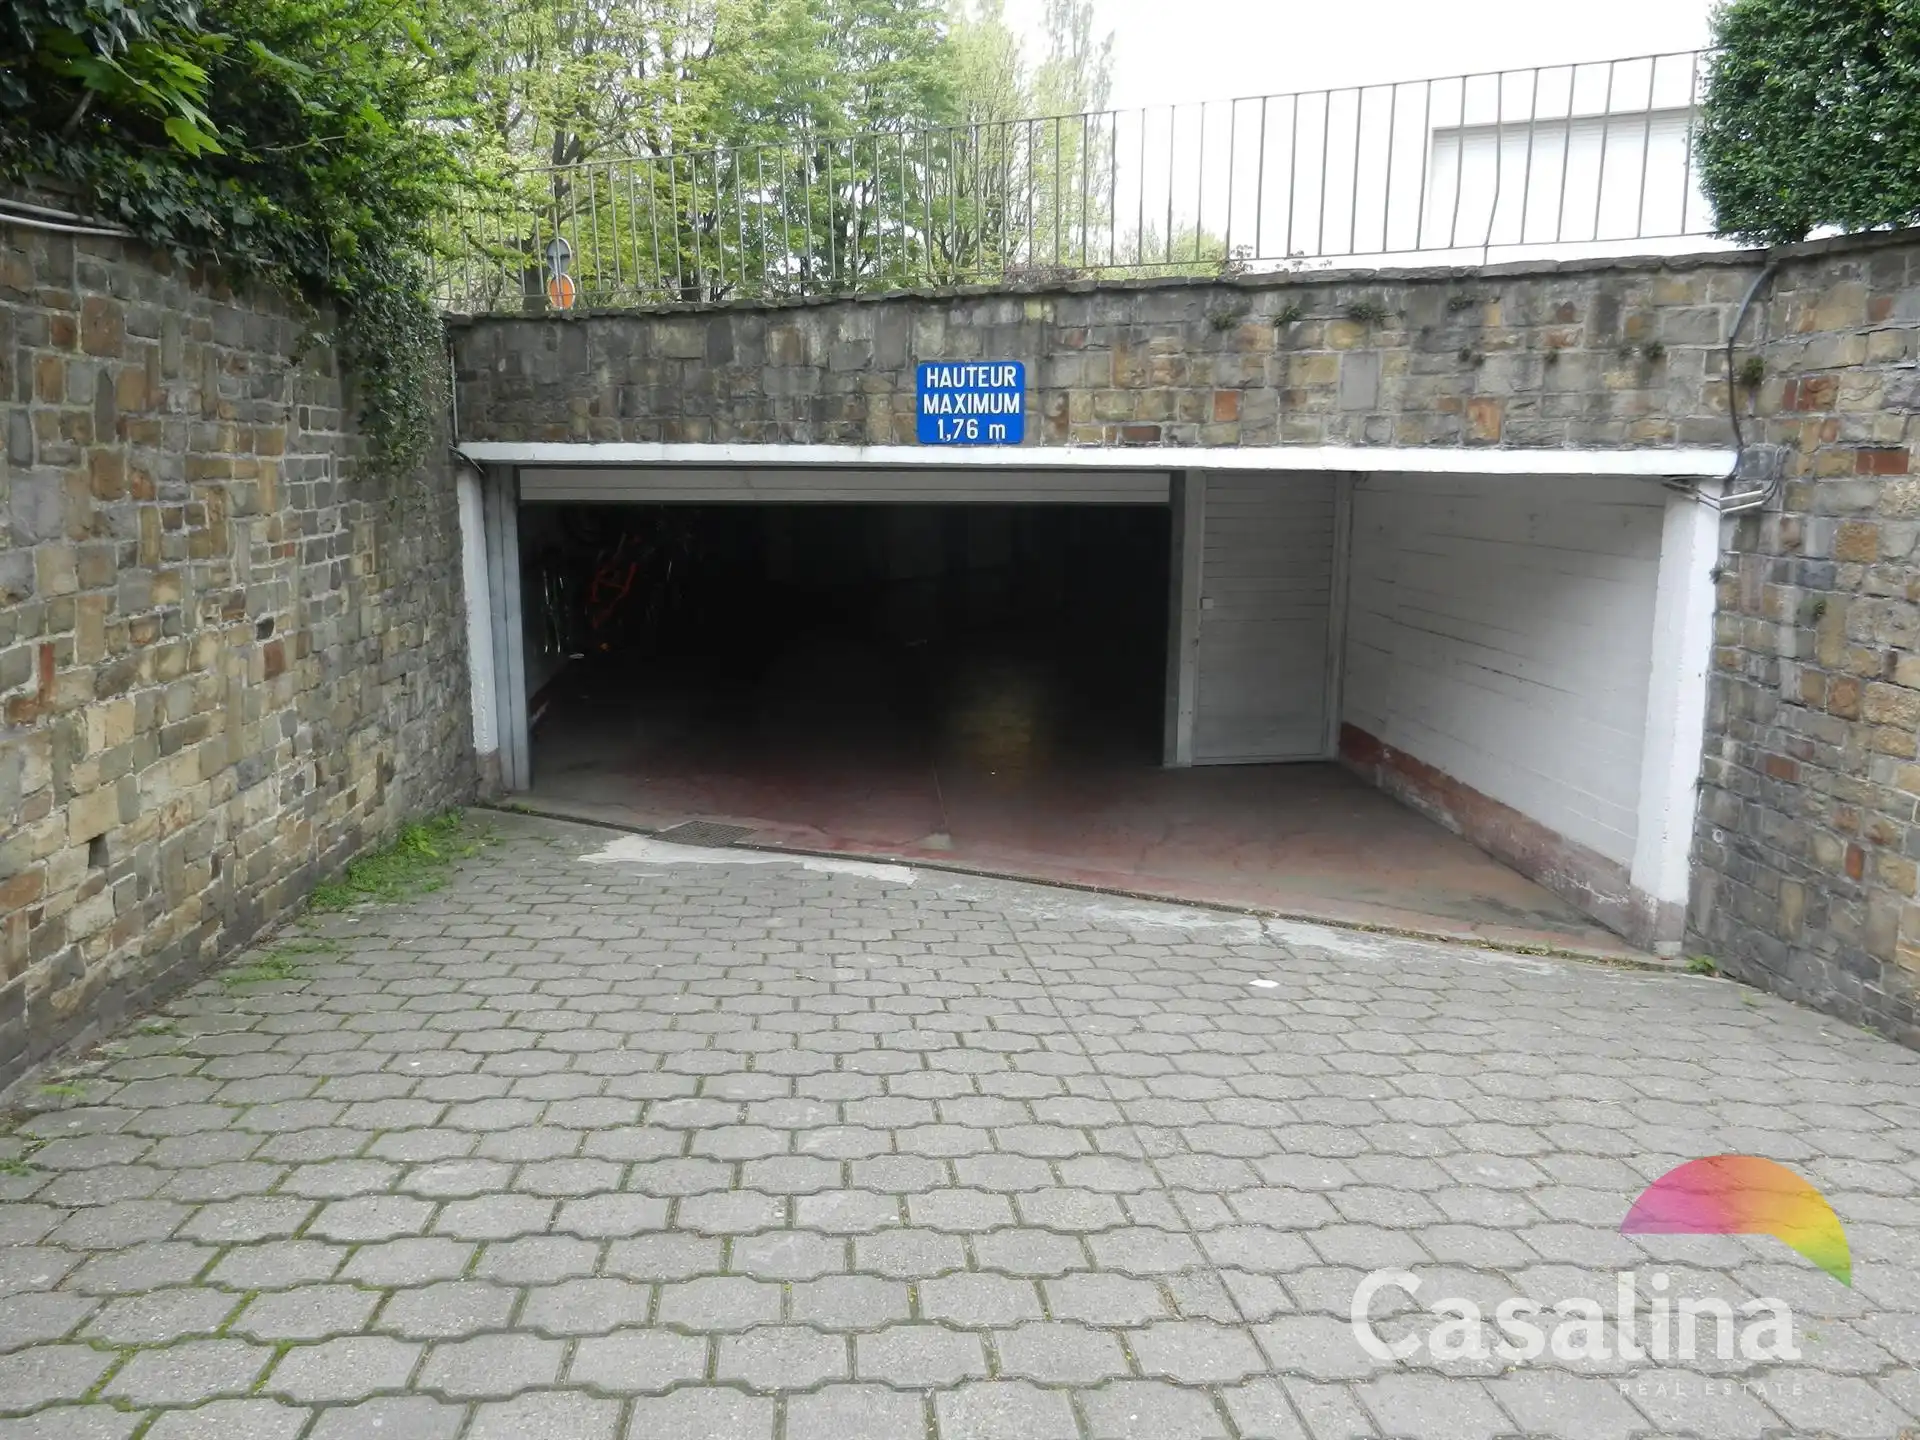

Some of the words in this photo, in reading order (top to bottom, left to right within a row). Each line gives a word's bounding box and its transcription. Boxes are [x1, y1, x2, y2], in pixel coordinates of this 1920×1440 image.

[926, 366, 1017, 388] HAUTEUR
[923, 392, 1020, 414] MAXIMUM
[937, 418, 979, 441] 1,76
[988, 423, 1006, 440] m
